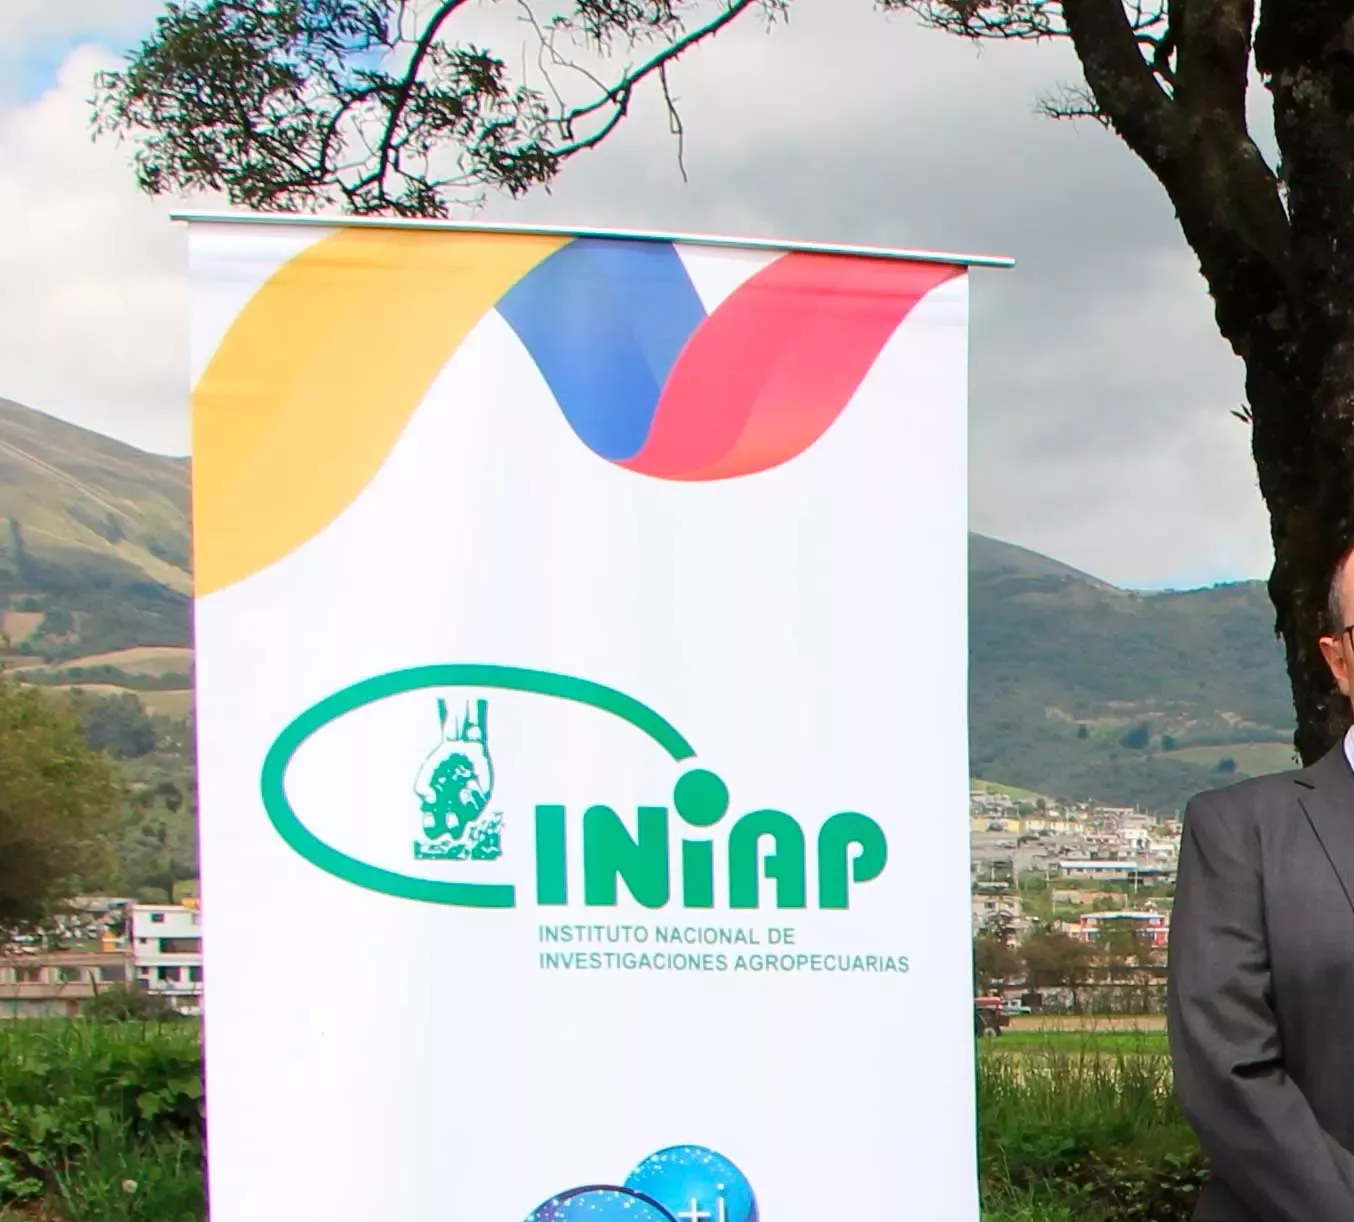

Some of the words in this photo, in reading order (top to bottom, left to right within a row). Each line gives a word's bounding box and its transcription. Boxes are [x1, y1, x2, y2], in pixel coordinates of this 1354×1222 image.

[538, 924, 650, 944] INSTITUTO
[655, 925, 761, 946] NACIONAL
[767, 927, 797, 946] DE
[539, 951, 728, 972] INVESTIGACIONES
[733, 953, 910, 974] AGROPECUARIAS
